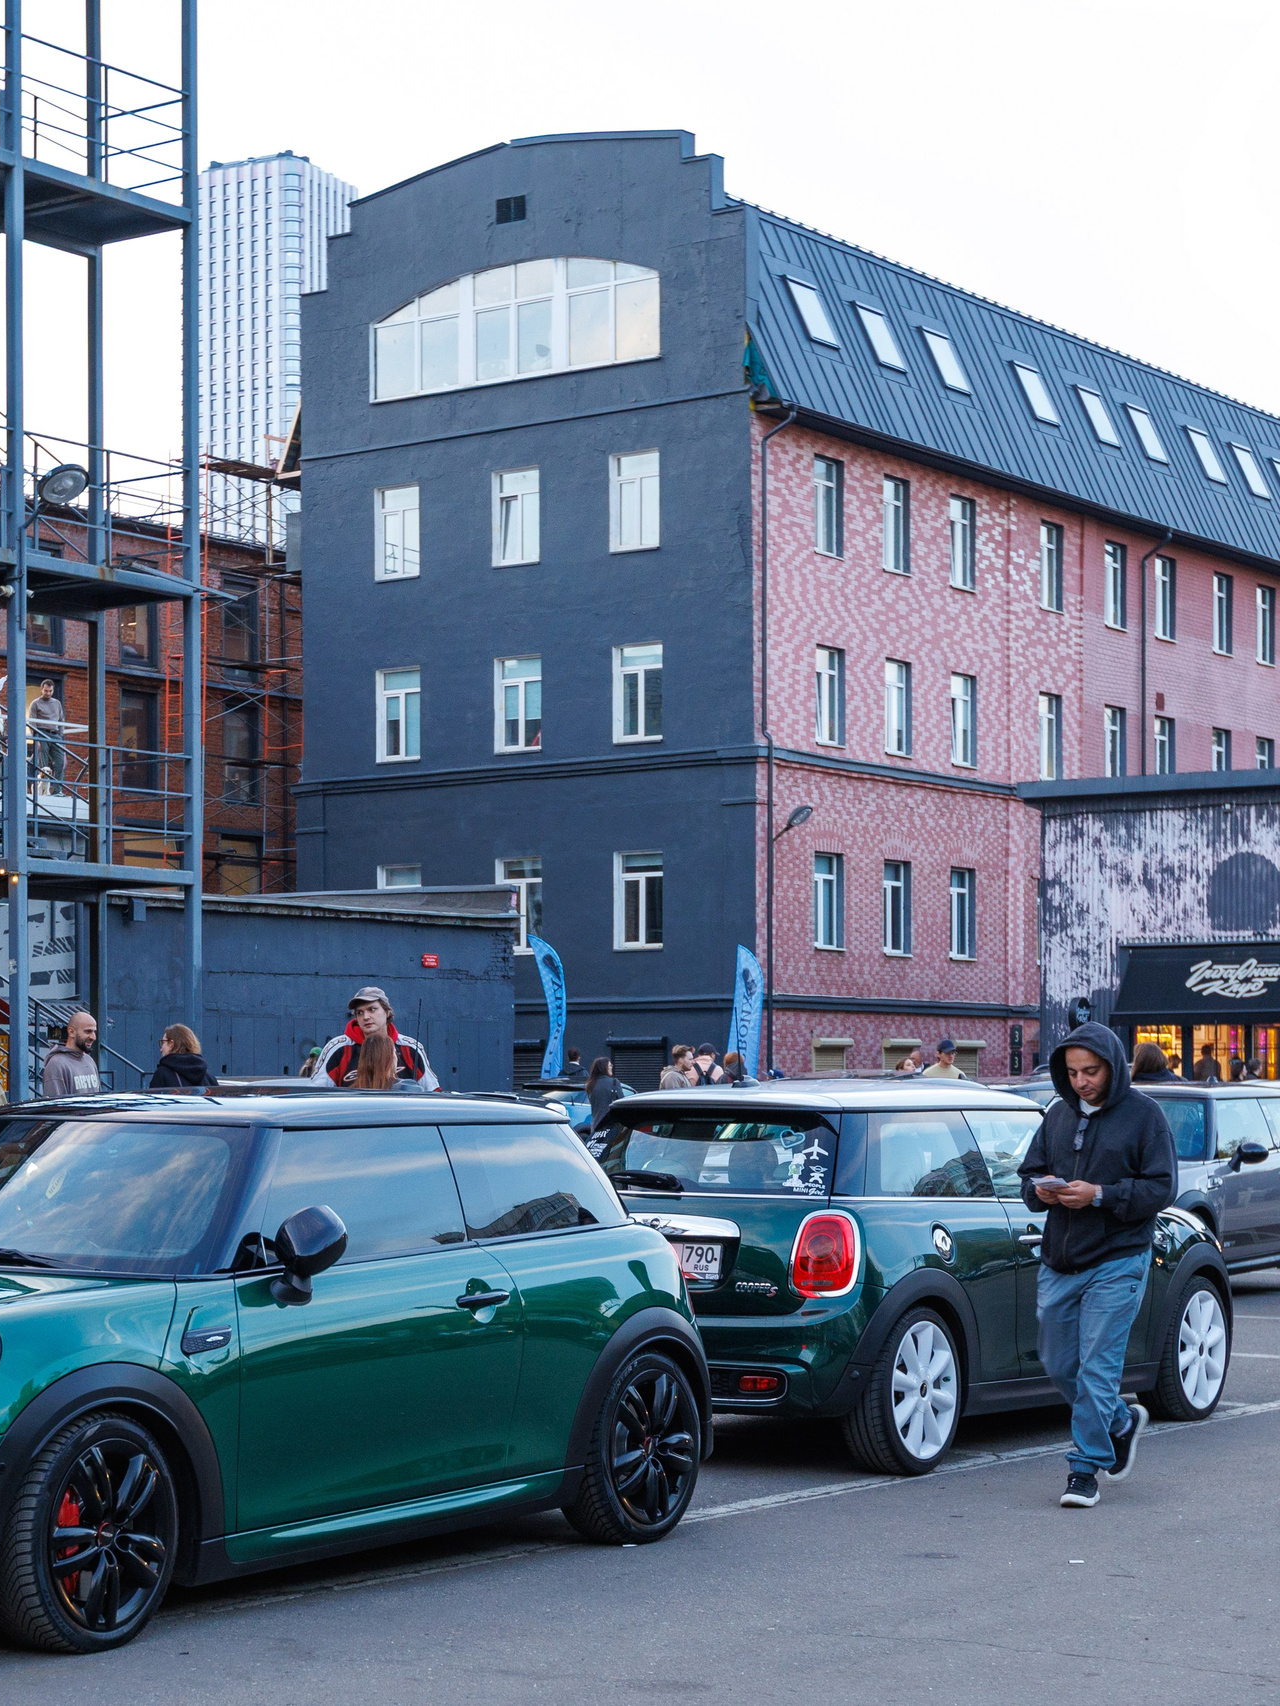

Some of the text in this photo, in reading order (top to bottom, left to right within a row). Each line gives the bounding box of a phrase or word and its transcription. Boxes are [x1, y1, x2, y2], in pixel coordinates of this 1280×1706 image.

[1015, 1030, 1020, 1042] 3
[1015, 1056, 1020, 1069] 3
[685, 1246, 715, 1264] 790
[735, 1282, 778, 1297] COOPER S
